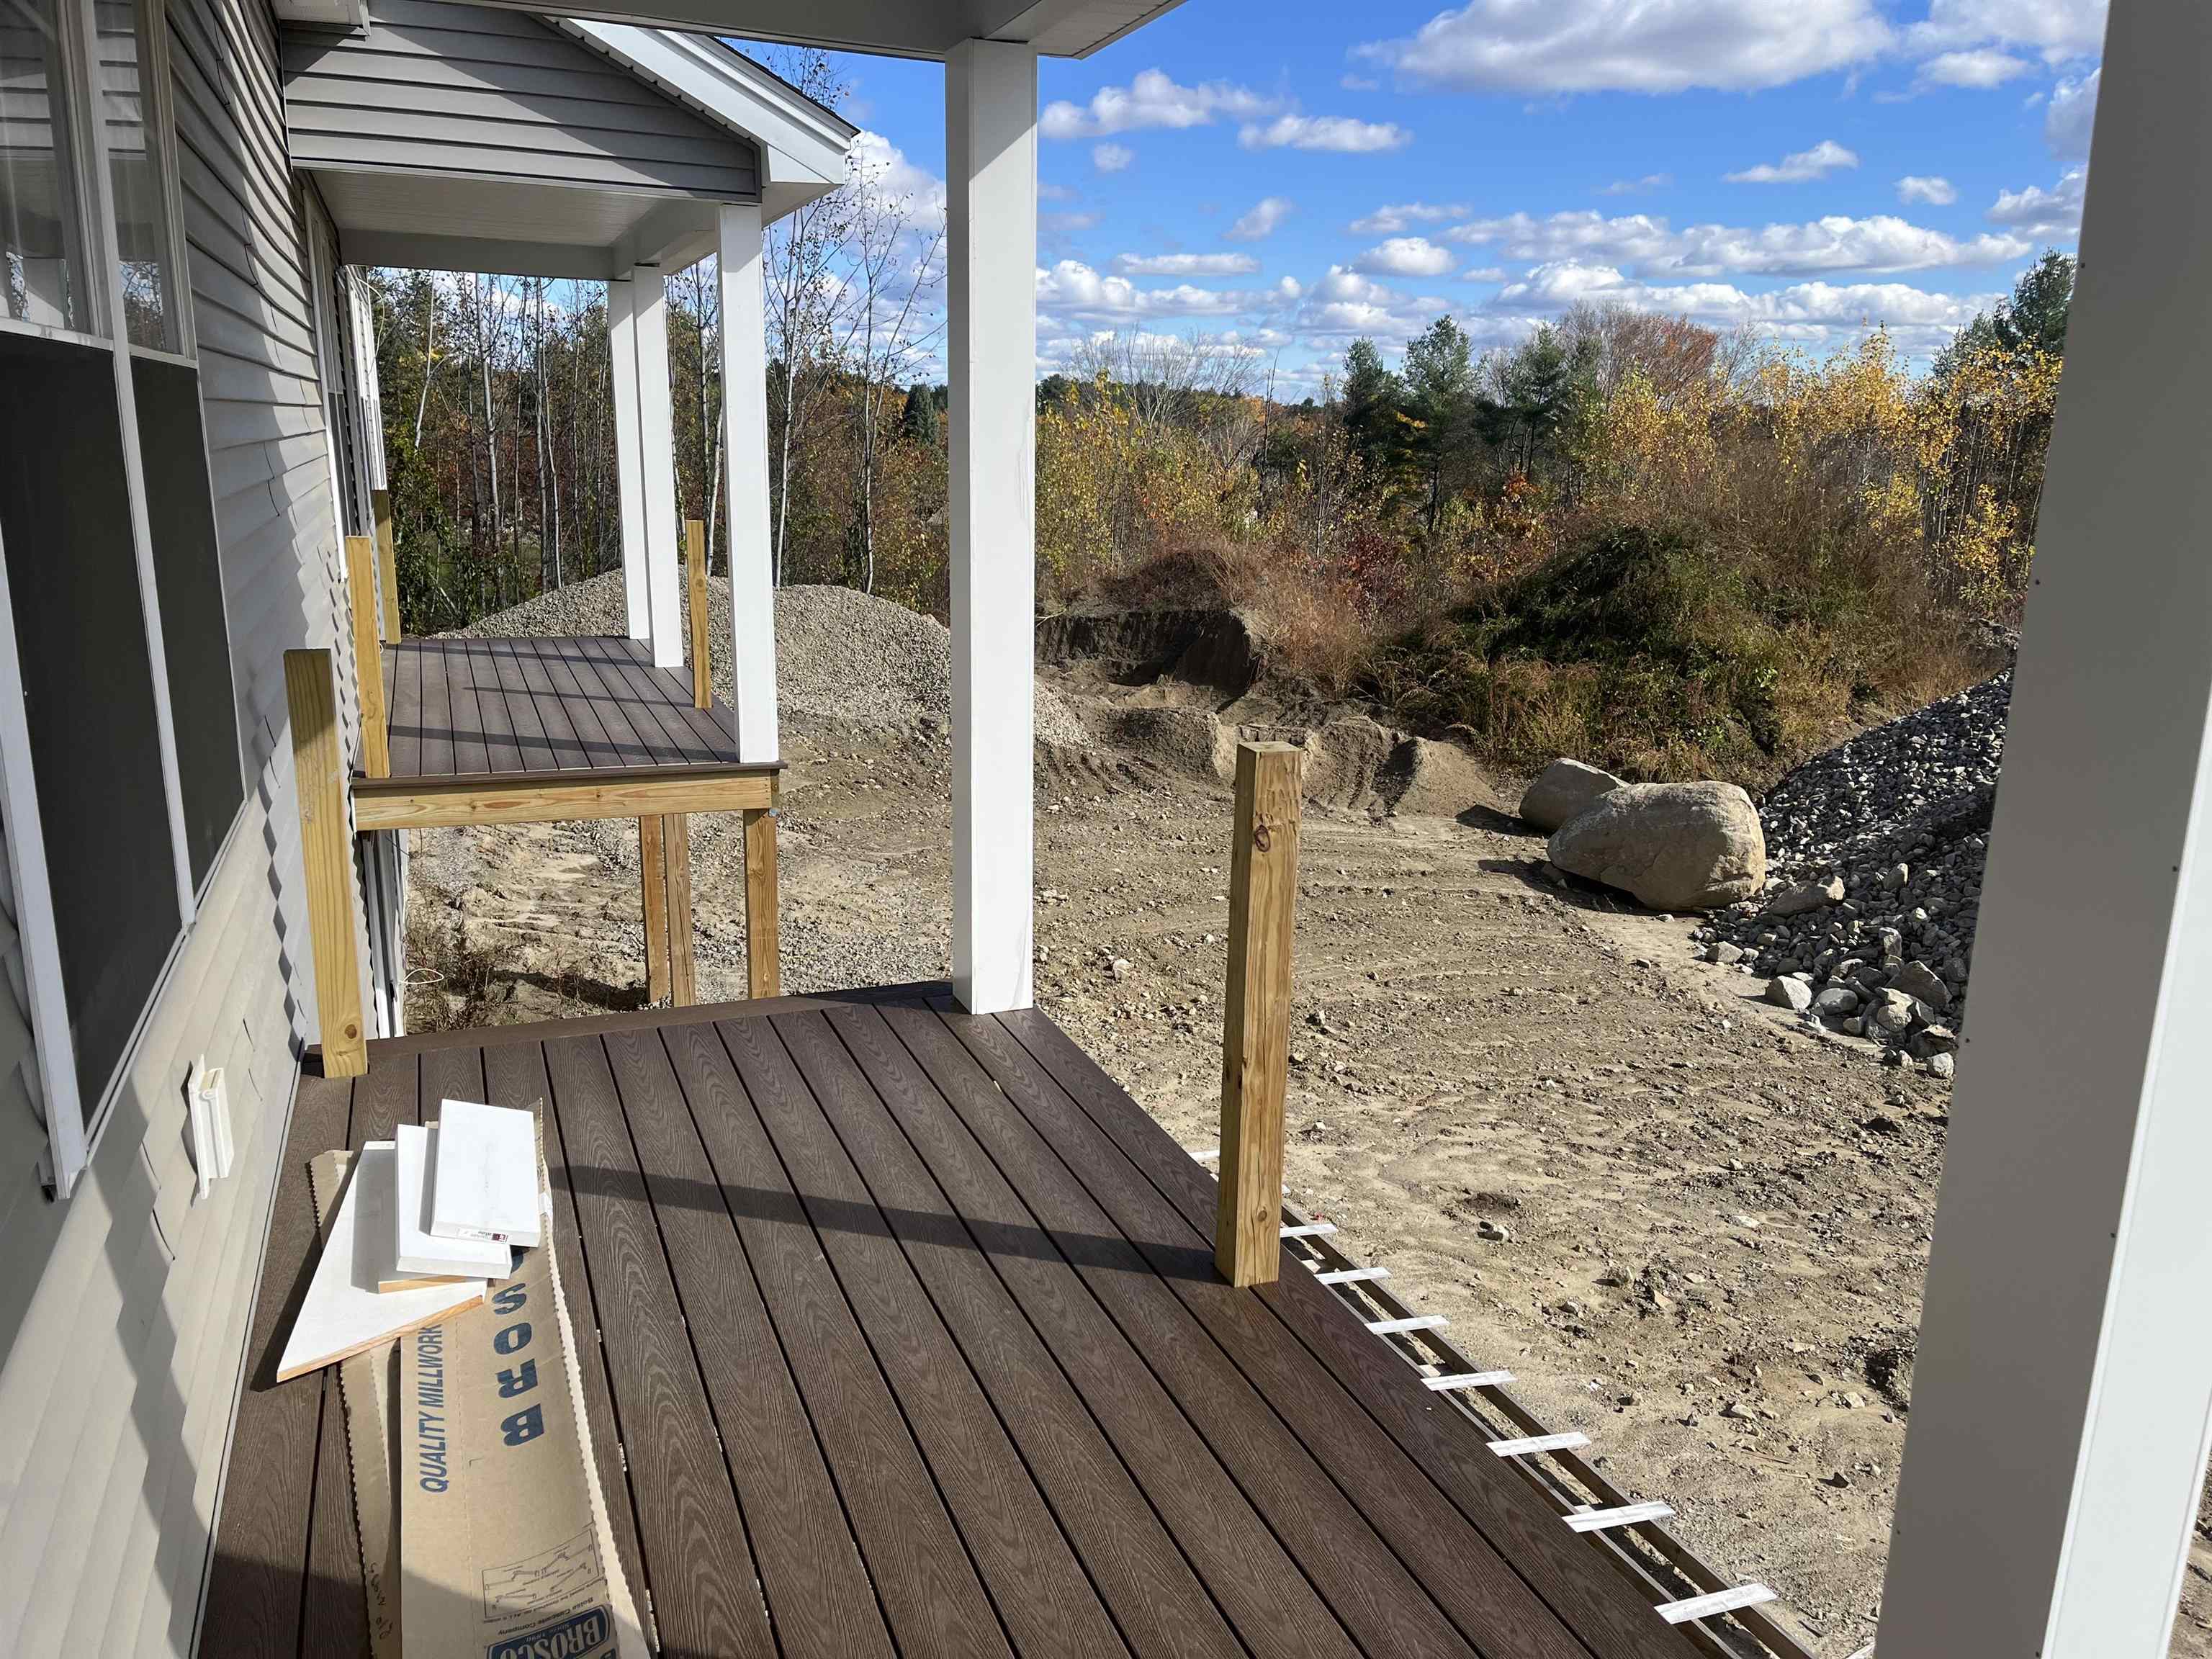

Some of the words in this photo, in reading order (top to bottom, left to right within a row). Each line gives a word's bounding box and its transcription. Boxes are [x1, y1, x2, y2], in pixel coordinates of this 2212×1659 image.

[418, 1323, 444, 1408] MILLWORK
[493, 1247, 544, 1446] BROS
[419, 1411, 449, 1493] QUALITY
[498, 1622, 536, 1635] Company
